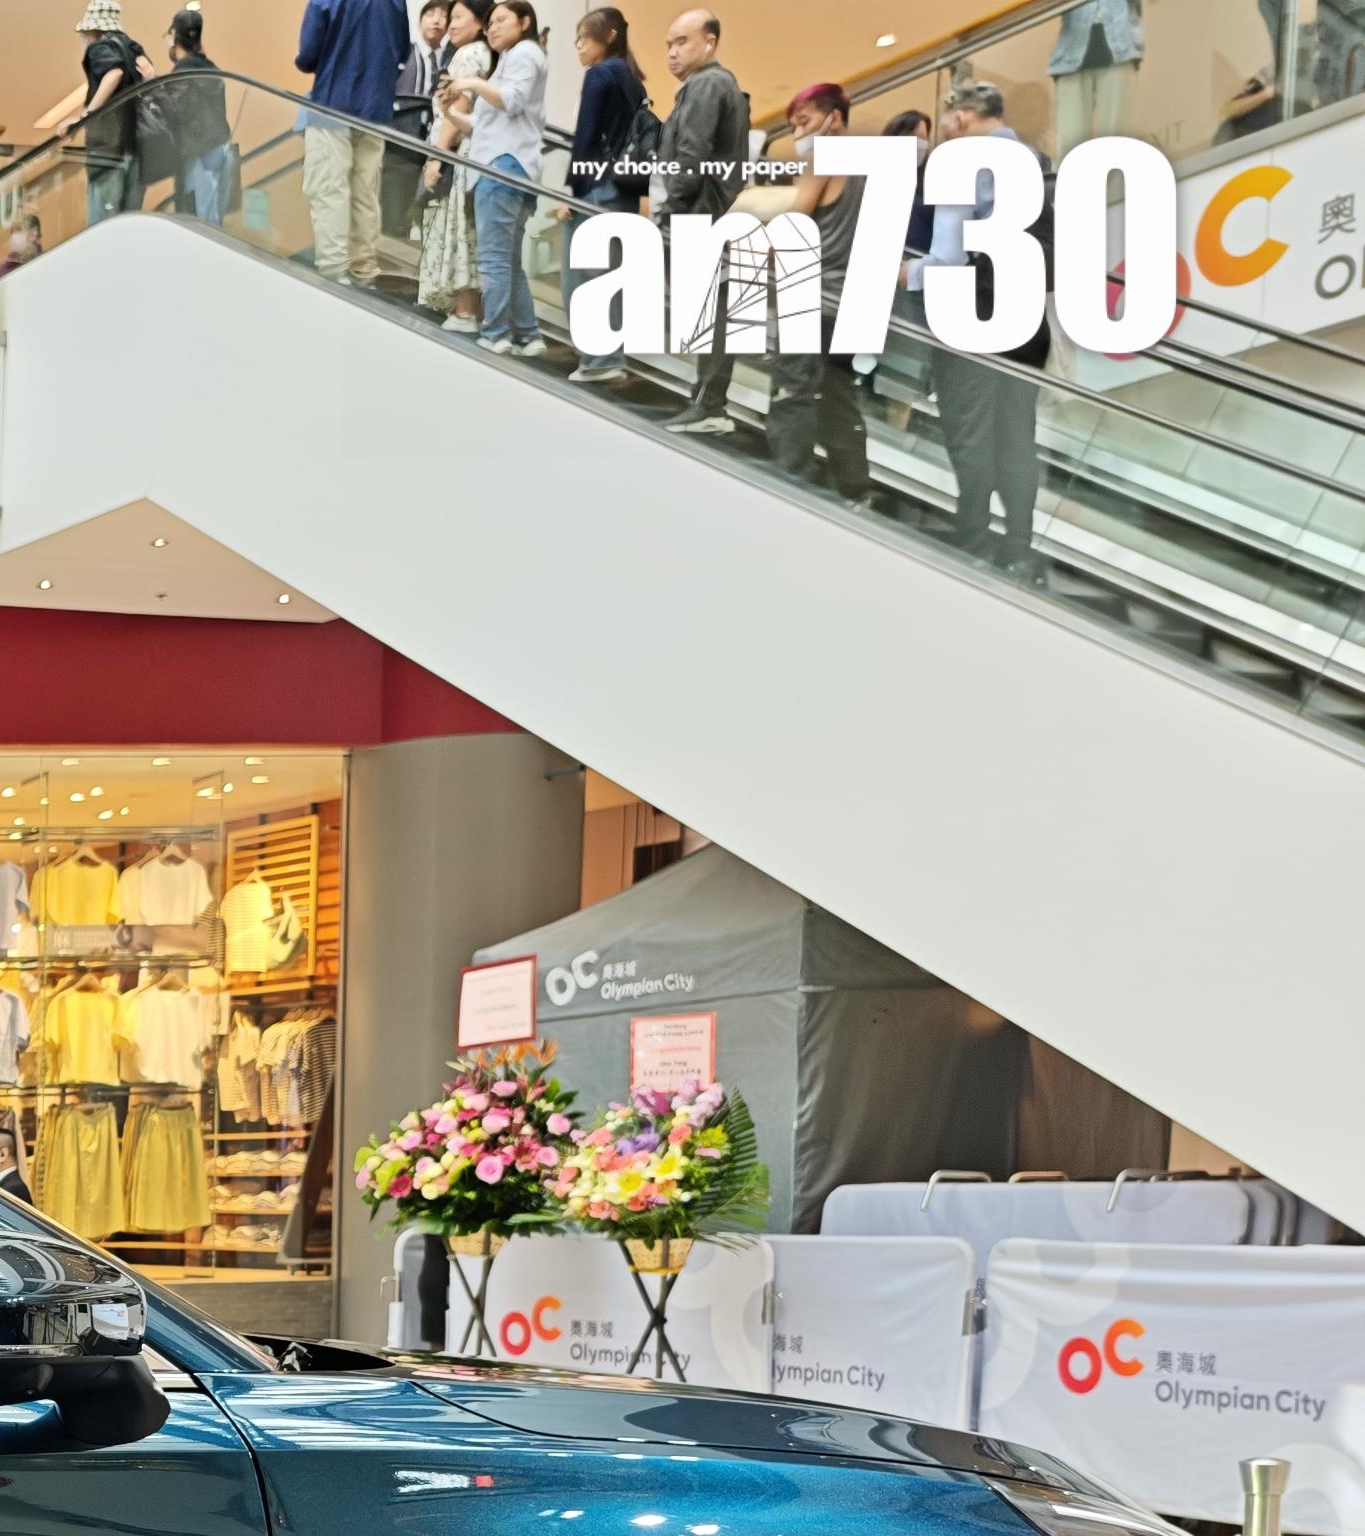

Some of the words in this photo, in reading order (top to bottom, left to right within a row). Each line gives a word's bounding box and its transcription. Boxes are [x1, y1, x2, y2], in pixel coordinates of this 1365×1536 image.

[545, 950, 599, 1007] OC
[600, 975, 663, 1000] Olympian
[663, 974, 694, 993] City
[499, 1294, 561, 1356] OC
[773, 1333, 803, 1354] 海城
[772, 1357, 843, 1385] lympian
[847, 1365, 885, 1392] City
[1057, 1317, 1146, 1394] OC
[1155, 1351, 1217, 1376] 奧海城
[1155, 1380, 1270, 1413] Olympian
[1274, 1390, 1326, 1422] City
